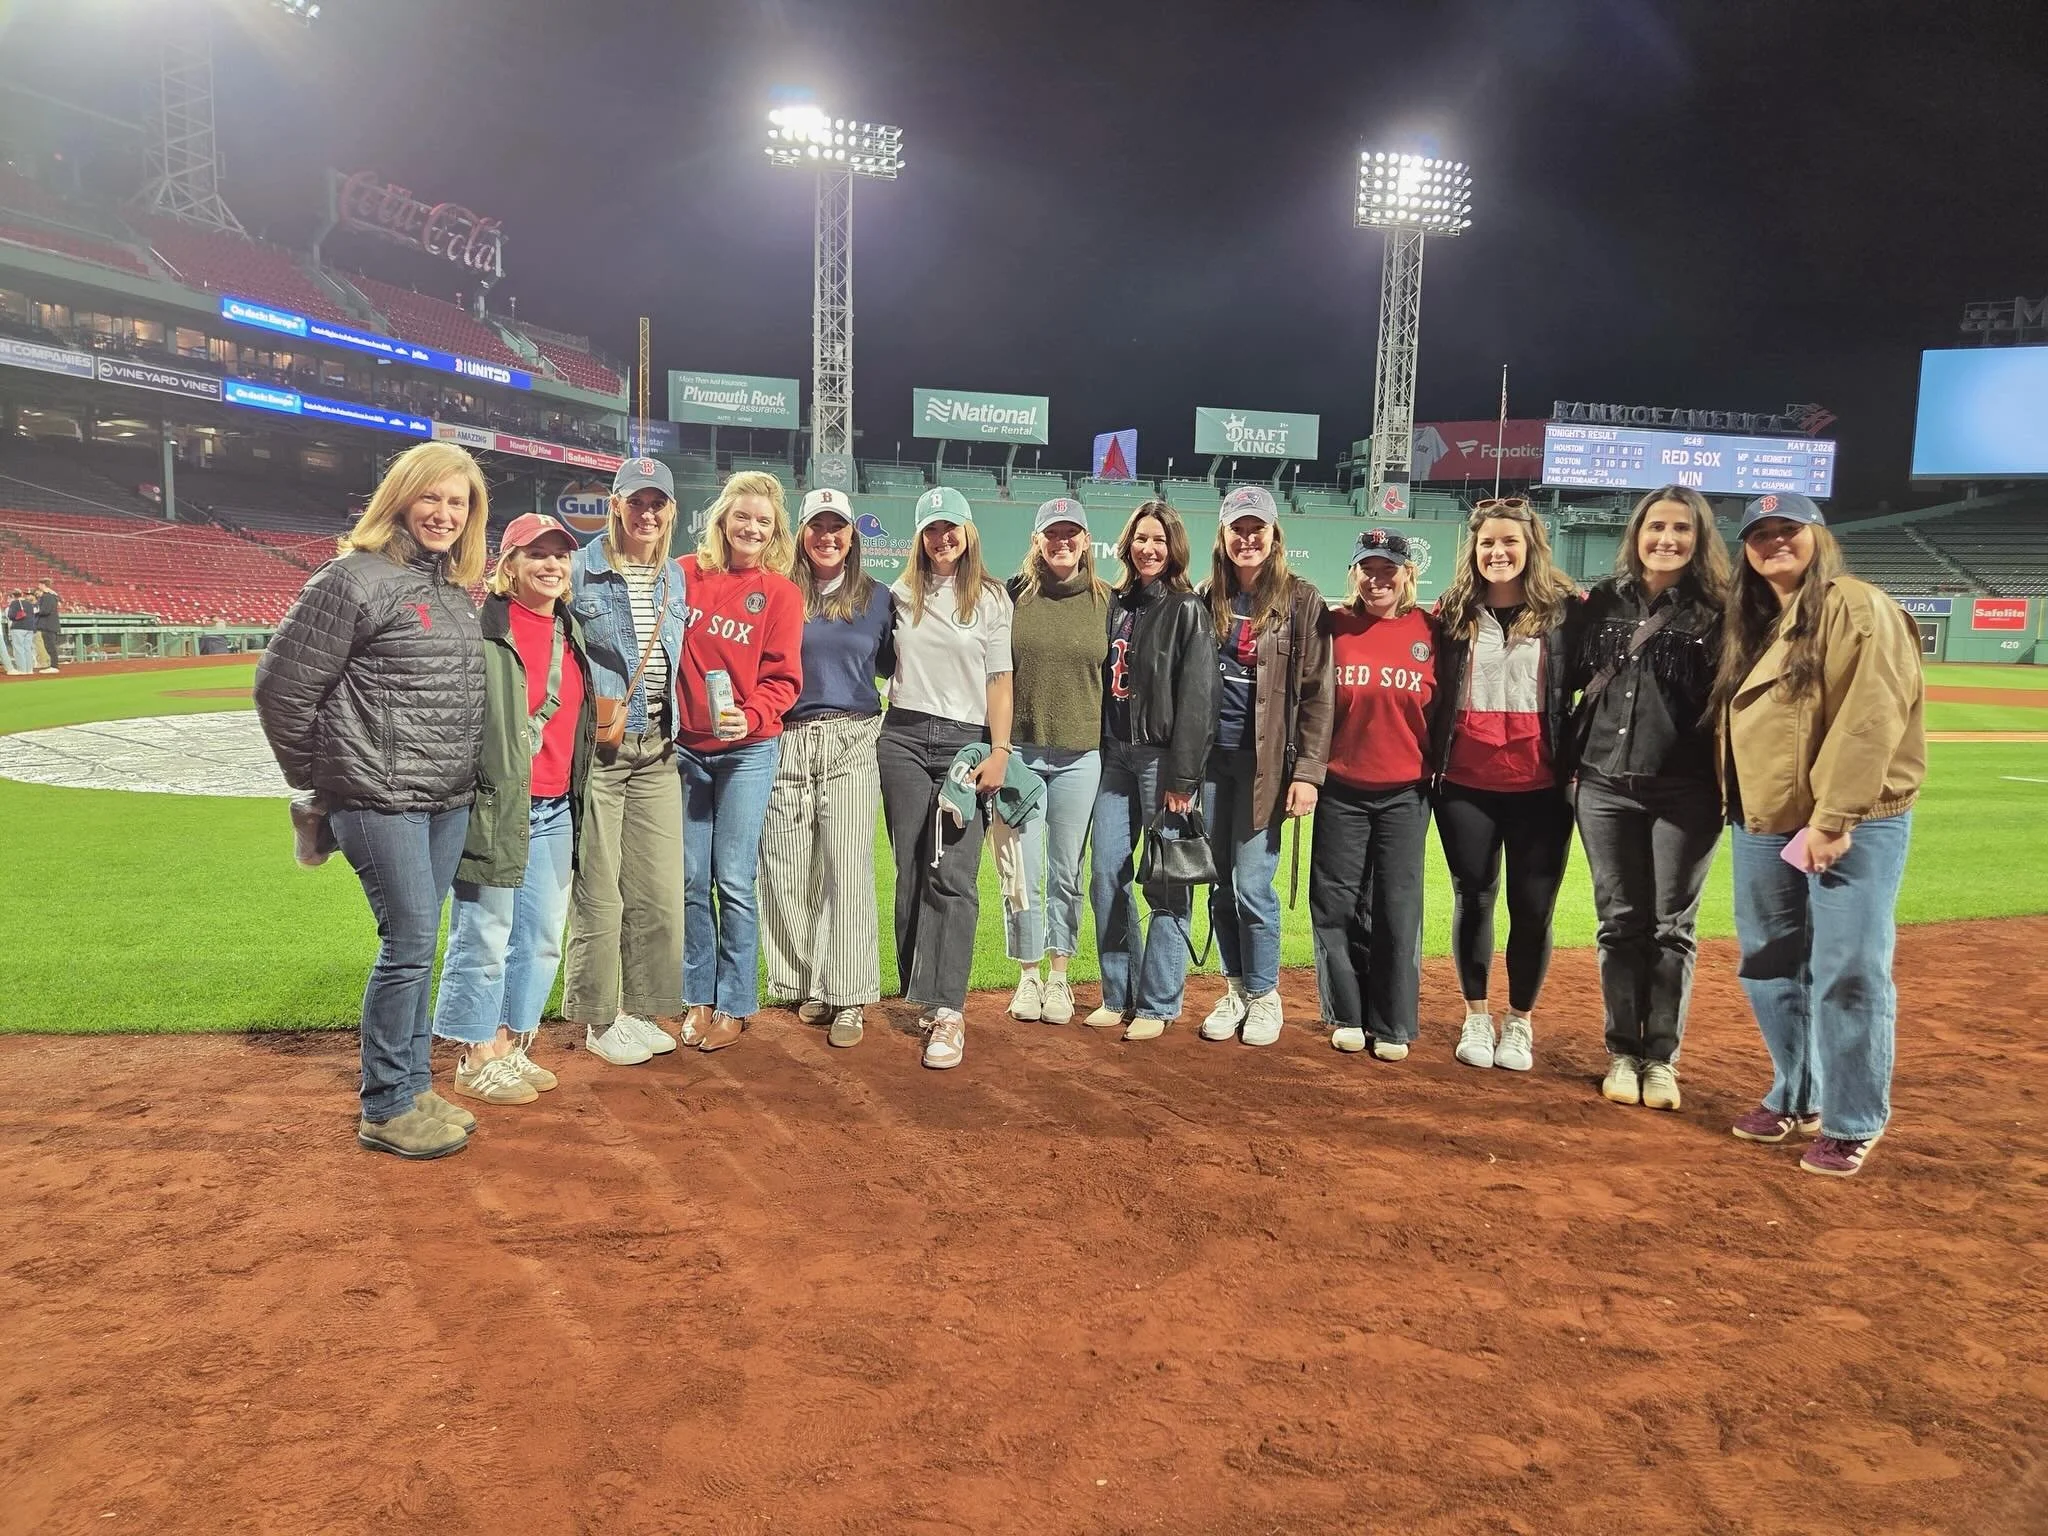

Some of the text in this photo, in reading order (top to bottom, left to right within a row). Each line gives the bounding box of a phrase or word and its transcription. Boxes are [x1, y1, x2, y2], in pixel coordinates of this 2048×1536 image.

[15, 348, 91, 367] COMPANIES
[468, 360, 511, 384] UNITED
[114, 366, 179, 386] VINEYARD
[181, 380, 218, 394] VINES
[683, 386, 786, 406] Plymouth Rock
[740, 404, 786, 415] assurance
[952, 401, 1036, 425] National
[1553, 400, 1784, 434] BANK OF AMERICA
[981, 424, 1032, 436] Car Rental
[1225, 427, 1288, 442] DRAFT
[1547, 429, 1617, 440] TONIGHT'S RESULT
[458, 431, 487, 444] AMAZING
[1683, 437, 1702, 447] 9:49
[1233, 440, 1286, 455] KINGS
[1481, 444, 1543, 459] Fanatics
[1553, 443, 1584, 453] HOUSTON
[1787, 442, 1804, 451] MAY
[1812, 444, 1833, 452] 2026
[568, 451, 598, 465] Safelite
[1554, 457, 1582, 465] BOSTON
[1606, 459, 1615, 467] 10
[1662, 449, 1721, 468] RED SOX
[1762, 455, 1793, 463] BENNETT
[1736, 467, 1747, 475] LP
[1679, 471, 1703, 486] WIN
[1737, 480, 1744, 488] S
[1761, 481, 1794, 490] CHAPMAN
[820, 491, 833, 503] B
[930, 493, 943, 508] B
[559, 496, 609, 515] Gul
[862, 538, 887, 548] RED
[1975, 608, 2025, 618] Safelite
[707, 615, 754, 645] SOX
[2000, 641, 2019, 649] 420
[1335, 665, 1423, 692] RED SOX
